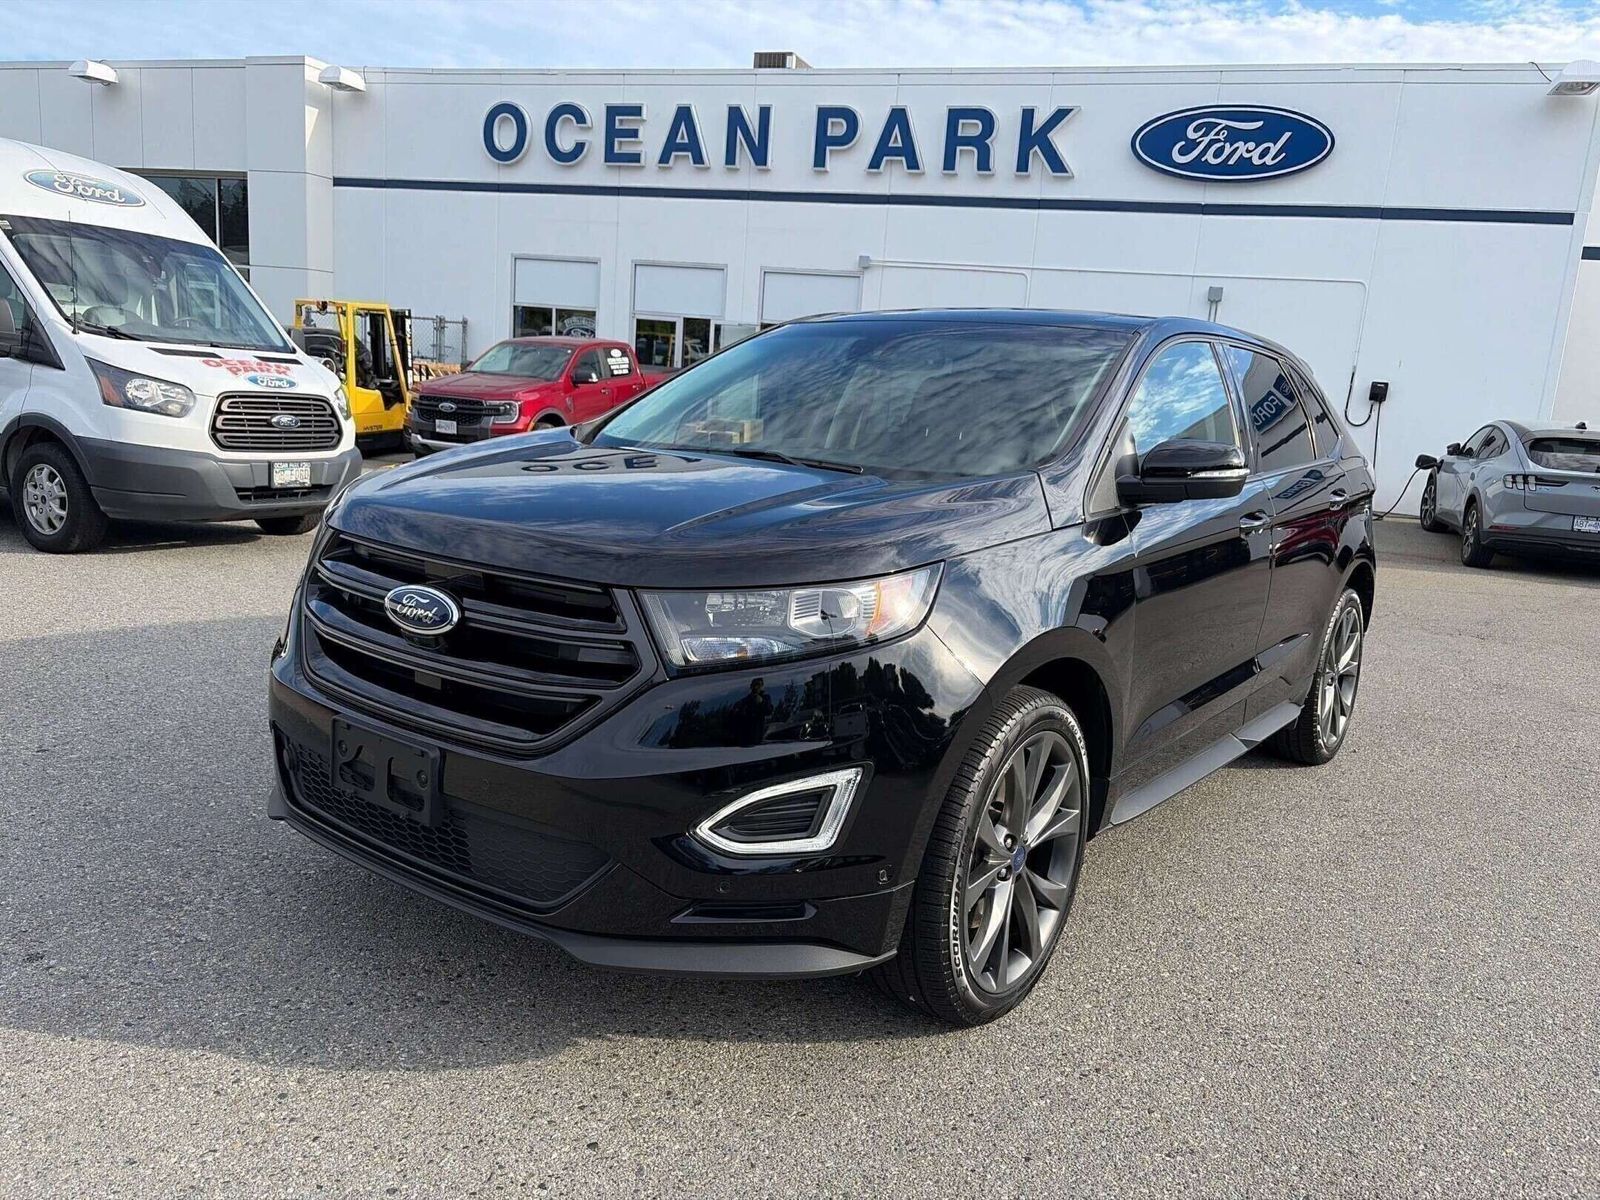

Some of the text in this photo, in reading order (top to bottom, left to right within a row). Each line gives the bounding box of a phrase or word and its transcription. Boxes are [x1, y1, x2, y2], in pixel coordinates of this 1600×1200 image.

[482, 101, 1081, 178] OCEAN PARK
[1171, 117, 1293, 166] Ford
[53, 173, 126, 203] Ford
[202, 359, 291, 371] OCEAN
[396, 593, 438, 624] Ford
[951, 873, 963, 979] SCORPION
